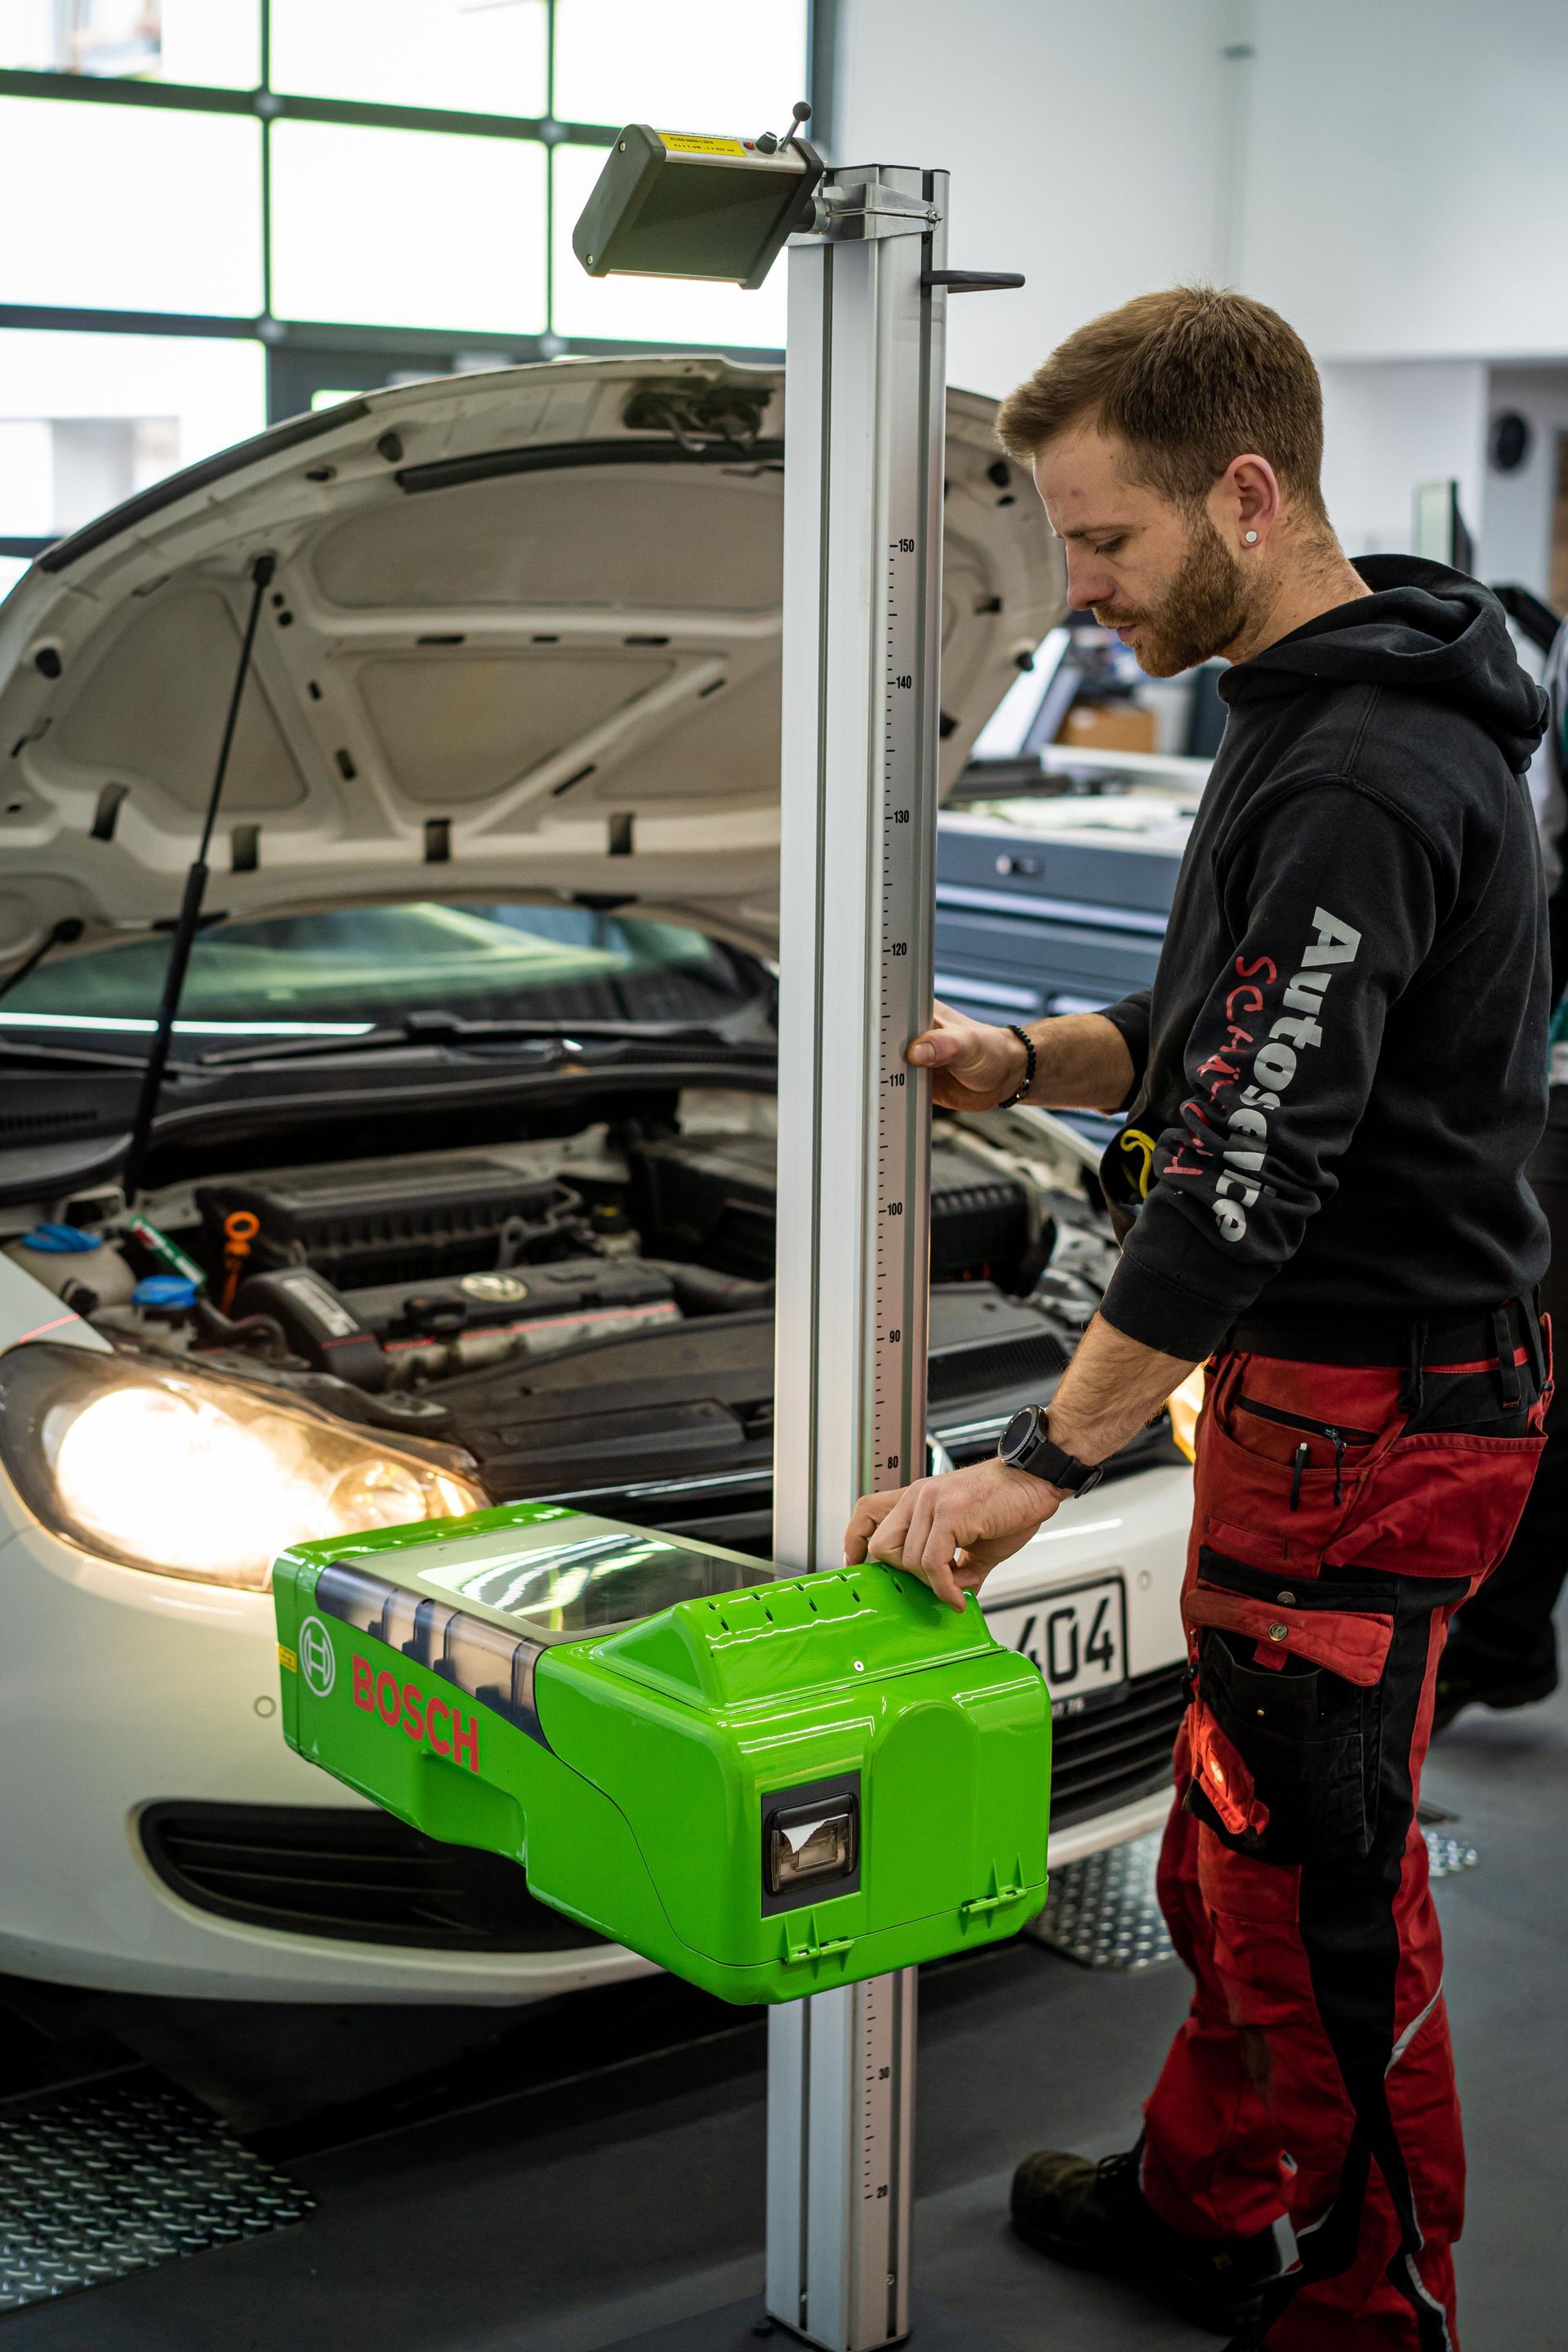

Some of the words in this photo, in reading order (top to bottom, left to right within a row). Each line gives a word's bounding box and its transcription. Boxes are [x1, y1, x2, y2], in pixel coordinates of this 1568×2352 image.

[898, 539, 915, 553] 150
[896, 675, 912, 688] 140
[893, 810, 910, 823] 130
[891, 942, 907, 956] 120
[889, 1073, 906, 1087] 110
[887, 1201, 902, 1216] 100
[889, 1330, 901, 1343] 90
[887, 1455, 898, 1469] 80
[352, 1652, 479, 1774] BOSCH
[878, 2066, 890, 2080] 30
[876, 2185, 888, 2198] 20
